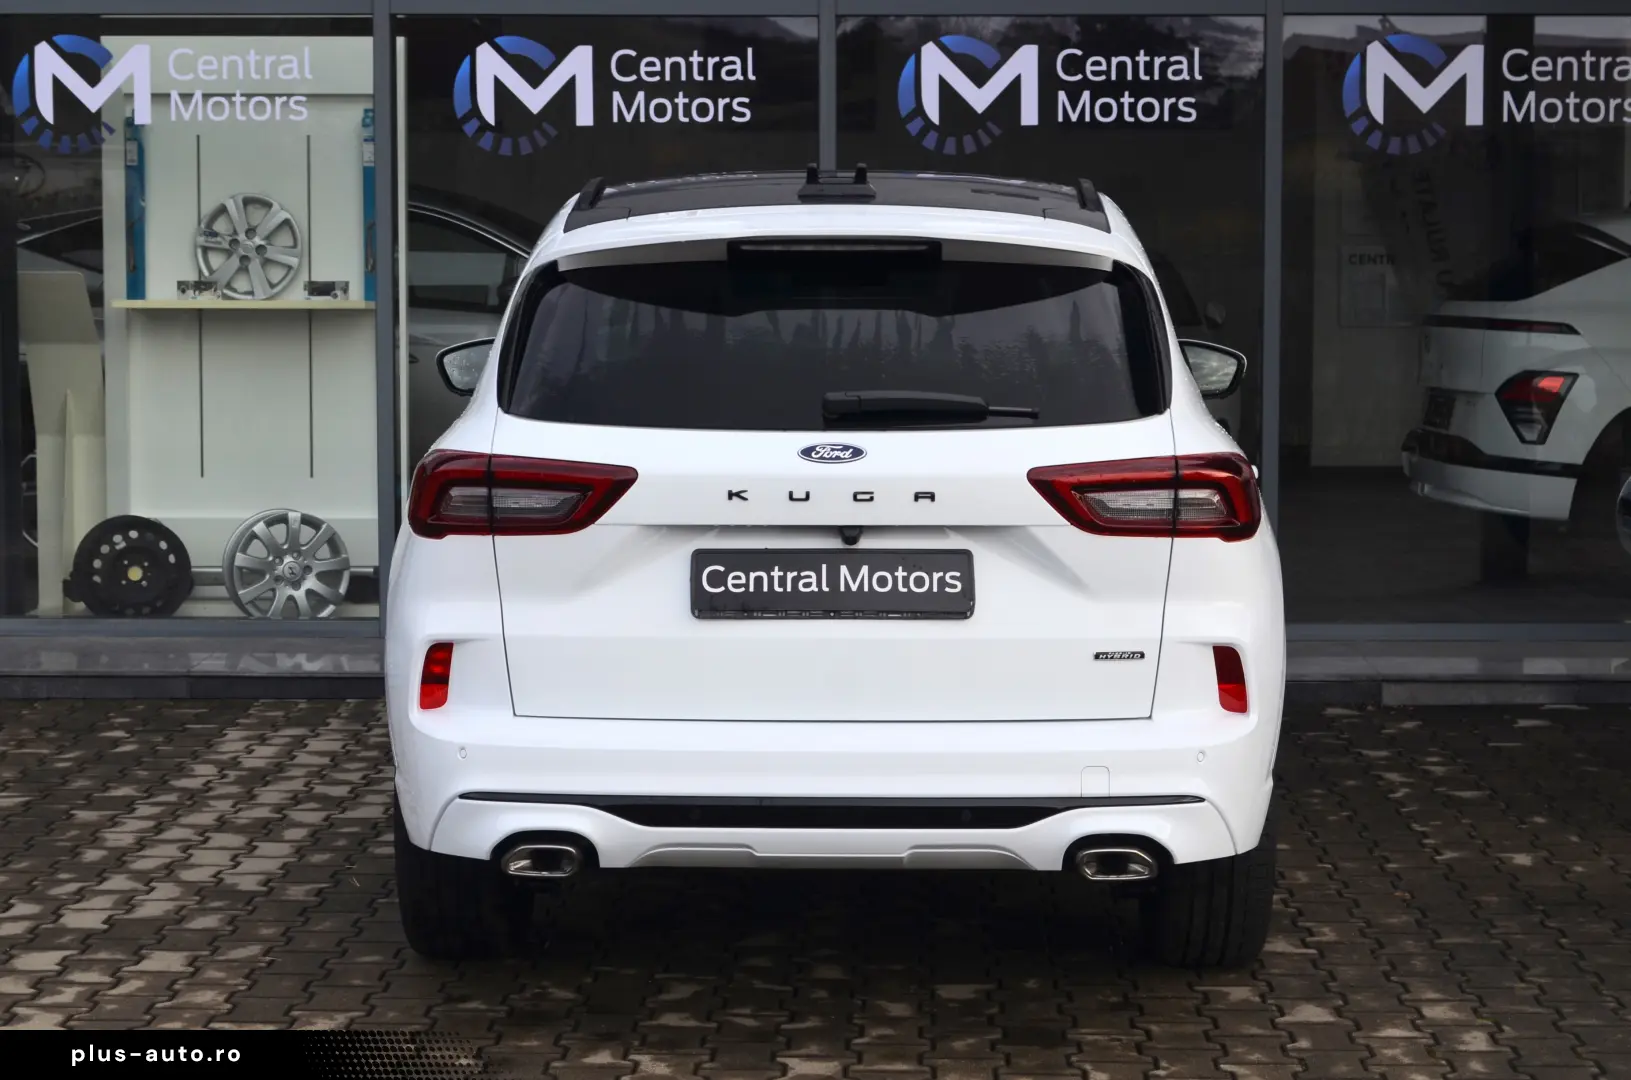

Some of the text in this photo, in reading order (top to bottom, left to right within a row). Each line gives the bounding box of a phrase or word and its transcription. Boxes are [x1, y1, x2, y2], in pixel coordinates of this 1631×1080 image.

[168, 46, 312, 82] Central
[610, 47, 757, 83] Central
[1056, 46, 1203, 82] Central
[1502, 48, 1631, 82] Centra
[169, 90, 308, 121] Motors
[612, 90, 752, 124] Motors
[1057, 90, 1197, 123] Motors
[811, 444, 854, 459] Ford
[727, 489, 936, 503] KUGA
[701, 563, 962, 593] Central Motors
[1098, 652, 1142, 660] HYBRID
